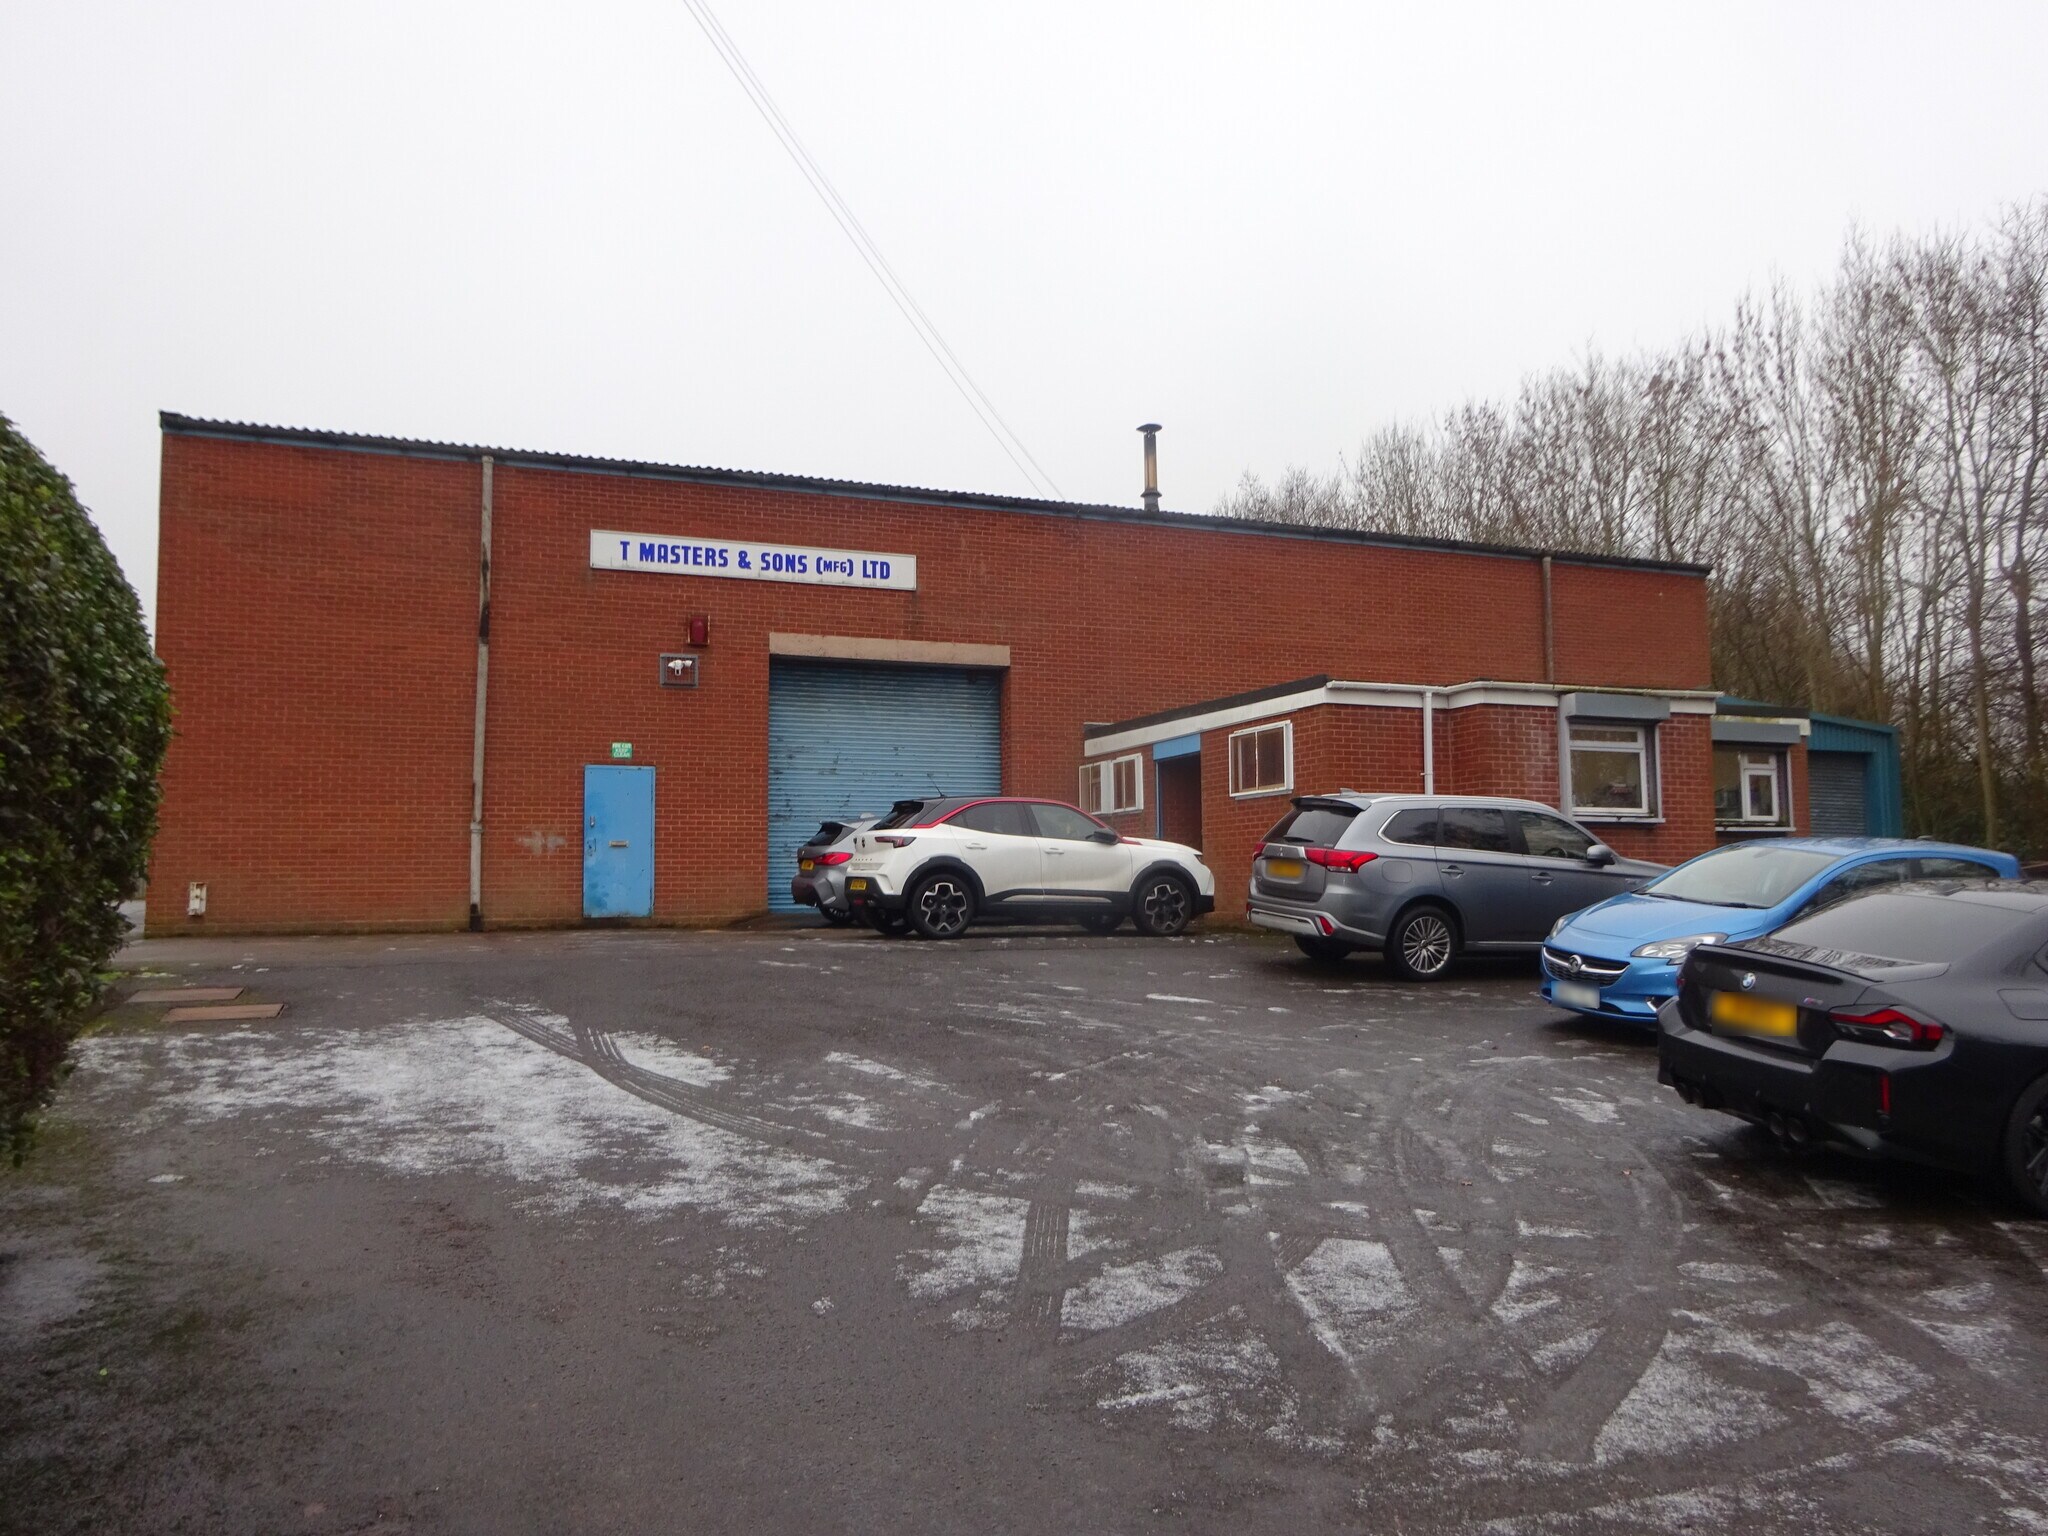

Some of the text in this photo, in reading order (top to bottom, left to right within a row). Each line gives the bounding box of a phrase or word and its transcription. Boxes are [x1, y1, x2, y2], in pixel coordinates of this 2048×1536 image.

[620, 540, 891, 580] T MASTERS & SONS (MFG) LTD
